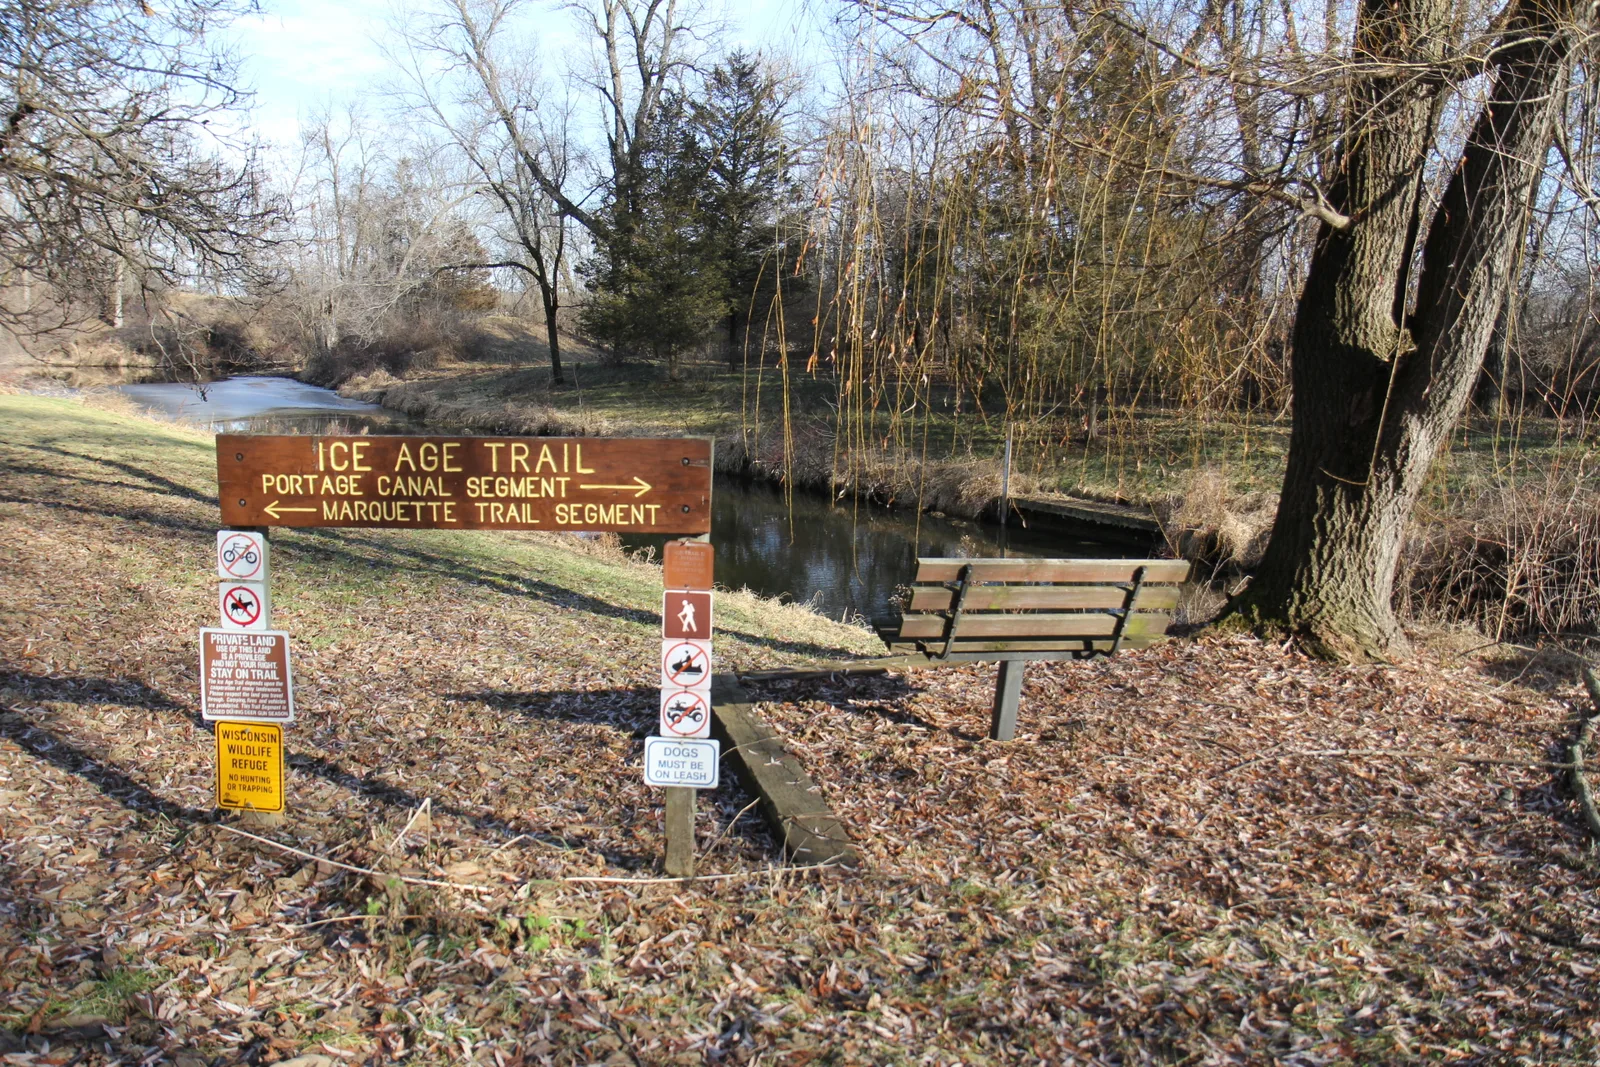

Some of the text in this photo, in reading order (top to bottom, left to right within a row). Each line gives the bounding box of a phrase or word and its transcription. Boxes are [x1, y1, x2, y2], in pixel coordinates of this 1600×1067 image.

[319, 442, 595, 474] ICE AGE TRAIL
[262, 474, 570, 497] PORTAGE CANAL SEGMENT
[323, 500, 660, 525] MARQUETTE TRAIL SEGMENT
[211, 634, 276, 646] PRIVATE LAND
[211, 668, 279, 679] STAY ON TRAIL
[222, 730, 277, 743] WISCONSIN
[228, 744, 272, 757] WILDLIFE
[664, 747, 698, 758] DOGS
[232, 759, 267, 770] REFUGE
[658, 760, 703, 770] MUST BE
[241, 775, 270, 784] HUNTING
[655, 770, 706, 780] ON LEASH
[239, 784, 272, 793] TRAPPING
